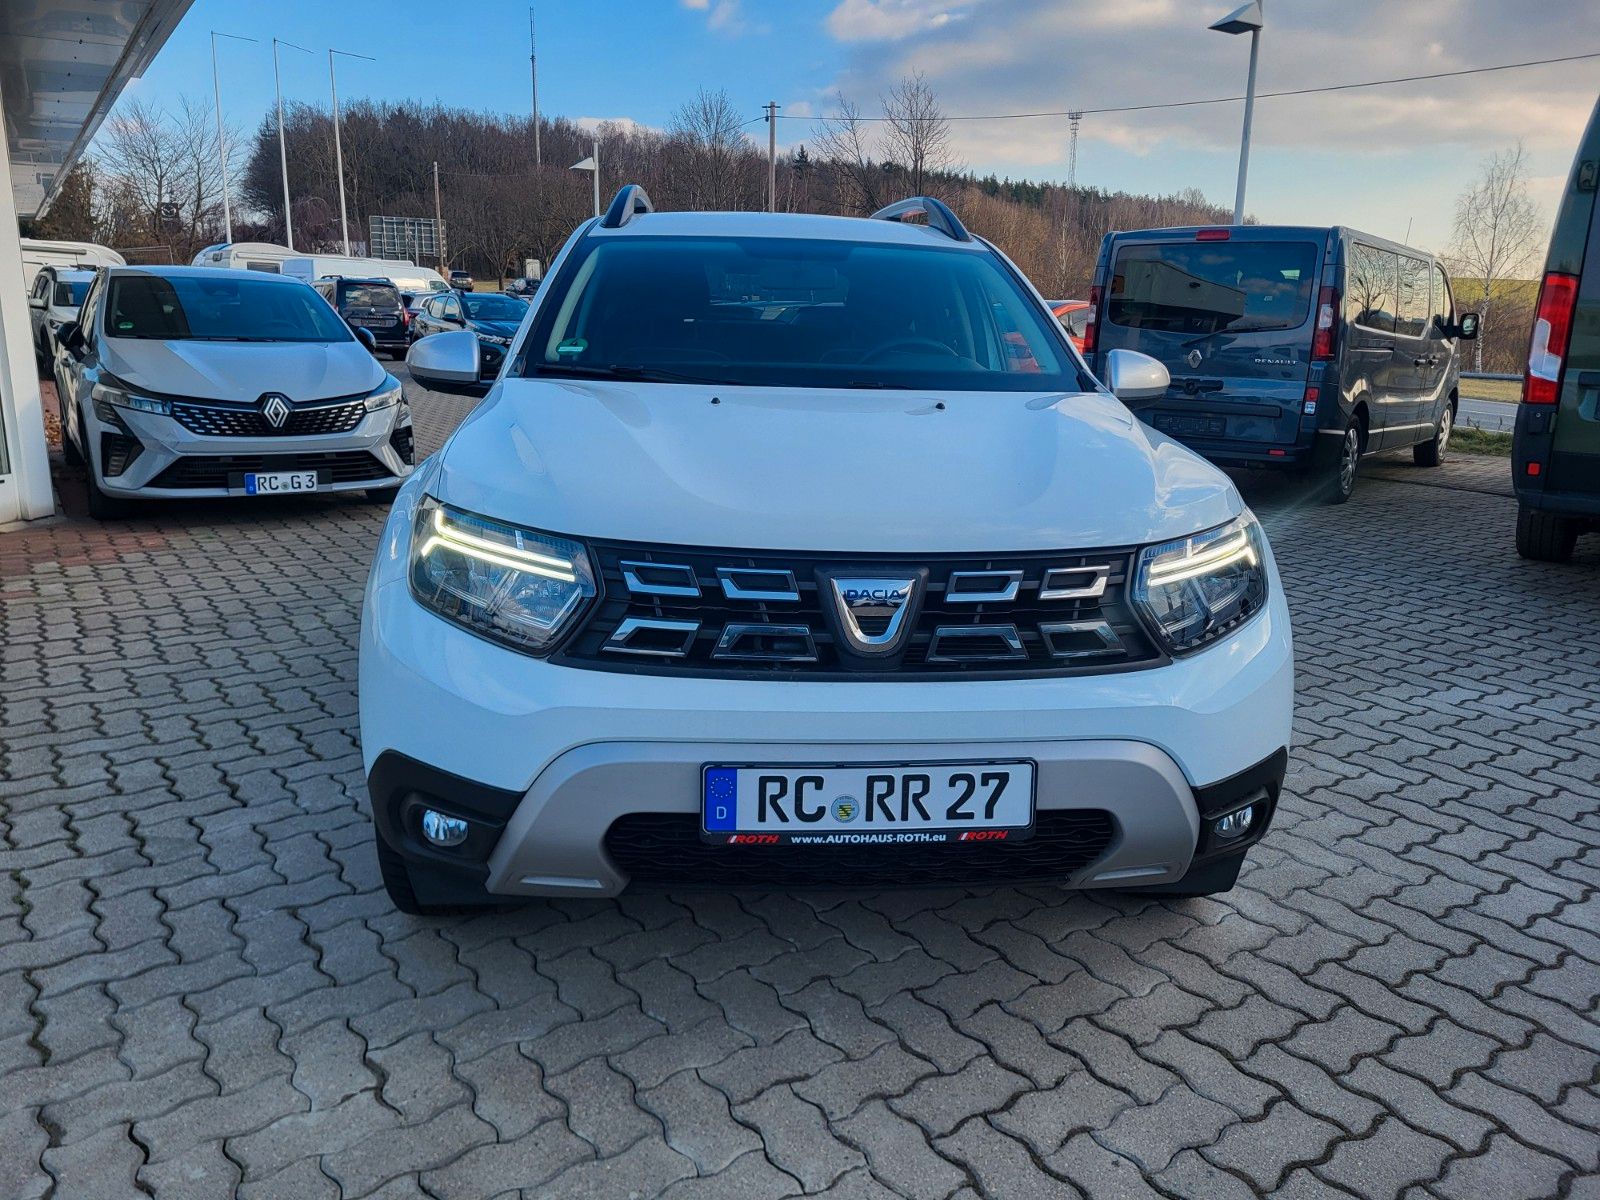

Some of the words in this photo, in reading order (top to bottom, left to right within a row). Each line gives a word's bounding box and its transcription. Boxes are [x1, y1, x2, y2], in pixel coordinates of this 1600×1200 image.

[257, 476, 279, 491] RC
[846, 589, 902, 599] DACIA
[716, 806, 727, 820] D
[758, 775, 826, 823] RC
[865, 774, 931, 822] RR
[946, 772, 1010, 820] 27
[735, 834, 780, 844] ROTH
[791, 833, 947, 844] www.AUTOHAUS-ROTH.eu
[966, 830, 1009, 840] ROTH
